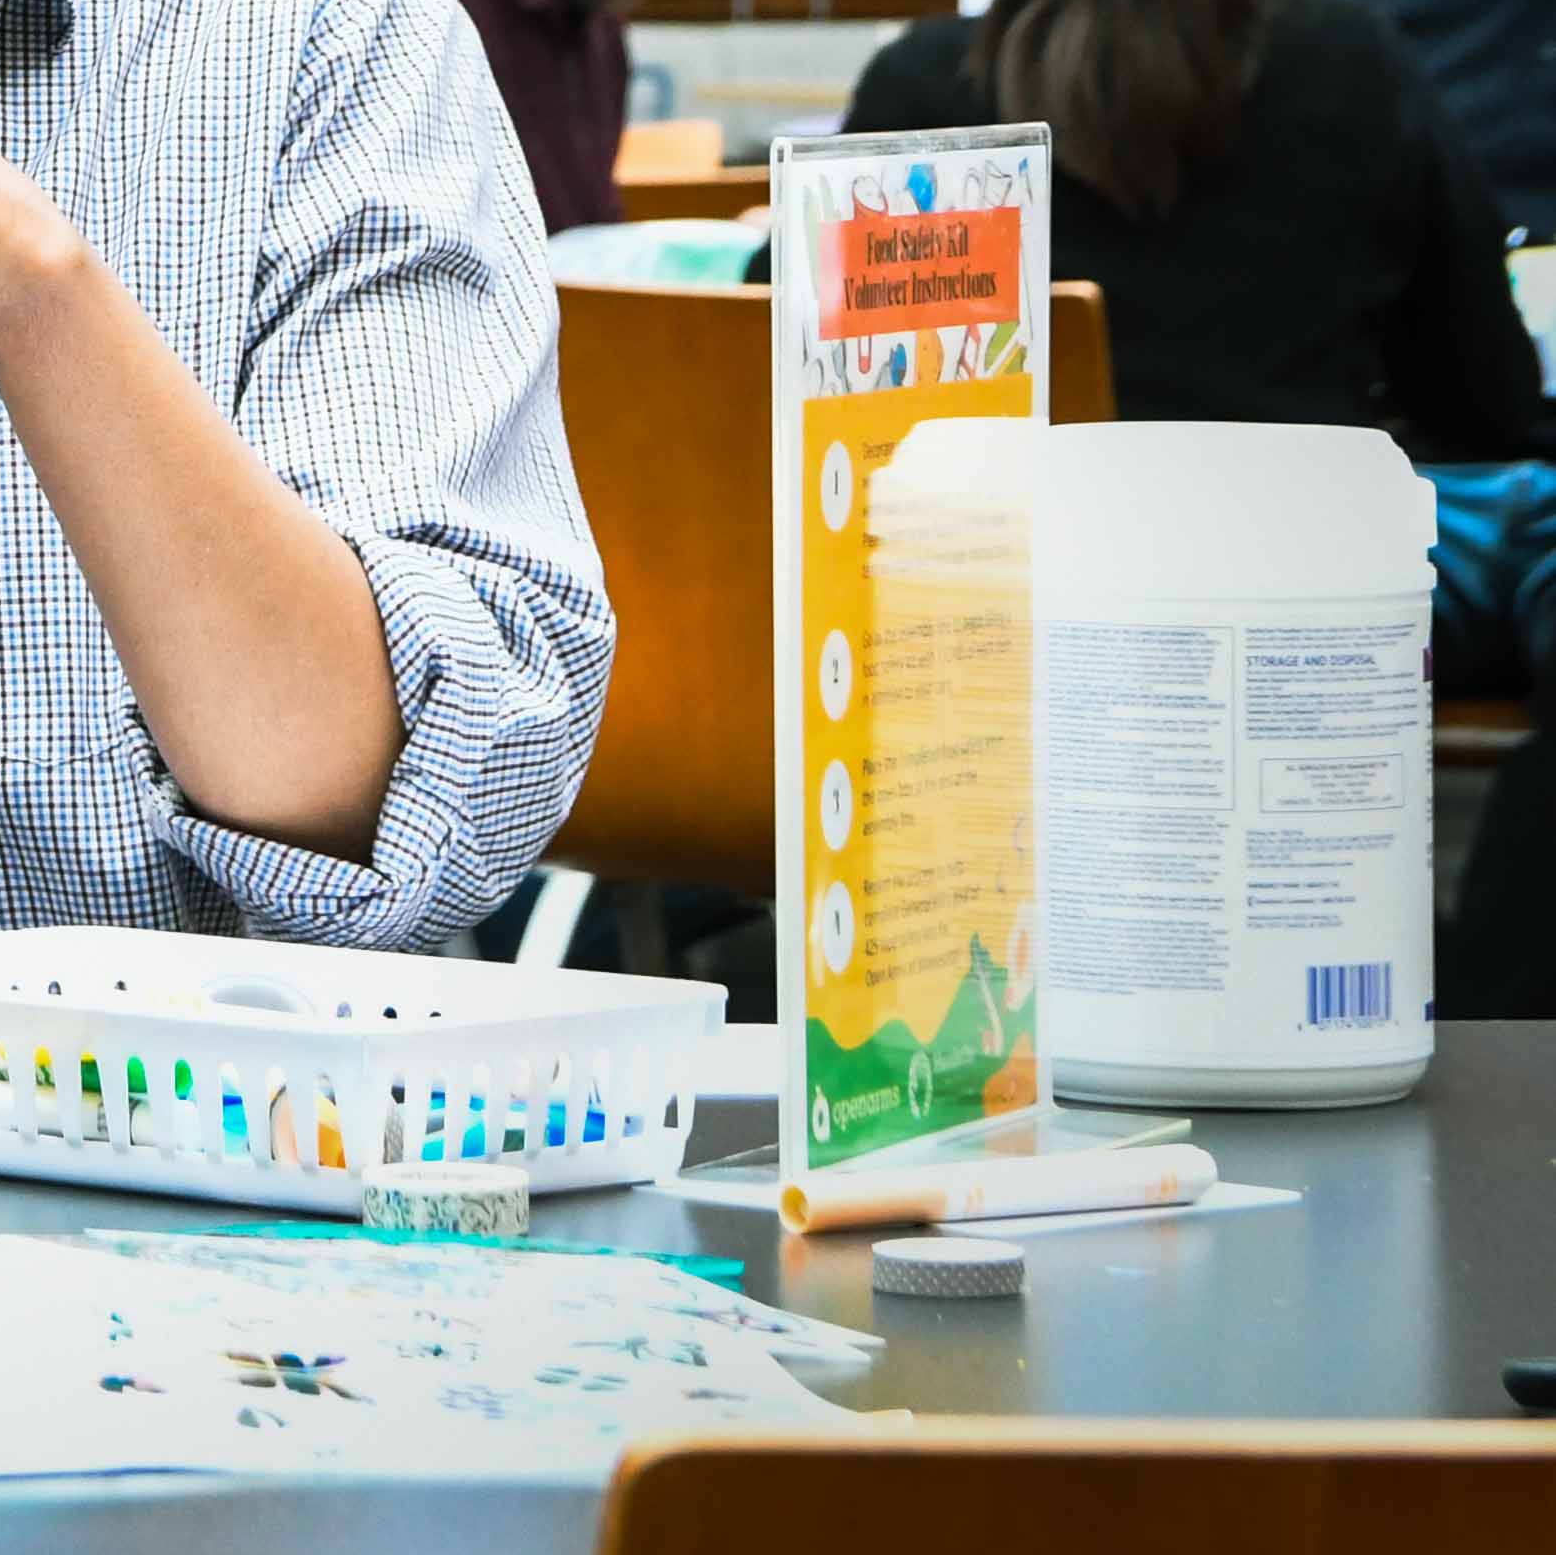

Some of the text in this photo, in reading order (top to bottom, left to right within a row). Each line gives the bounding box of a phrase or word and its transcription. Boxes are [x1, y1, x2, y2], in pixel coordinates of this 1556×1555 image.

[866, 221, 969, 266] Food Safety Kit
[844, 263, 996, 311] Volunteer Instructions
[1246, 655, 1299, 667] STORAGE
[1303, 654, 1327, 666] AND
[833, 1085, 900, 1130] openarms
